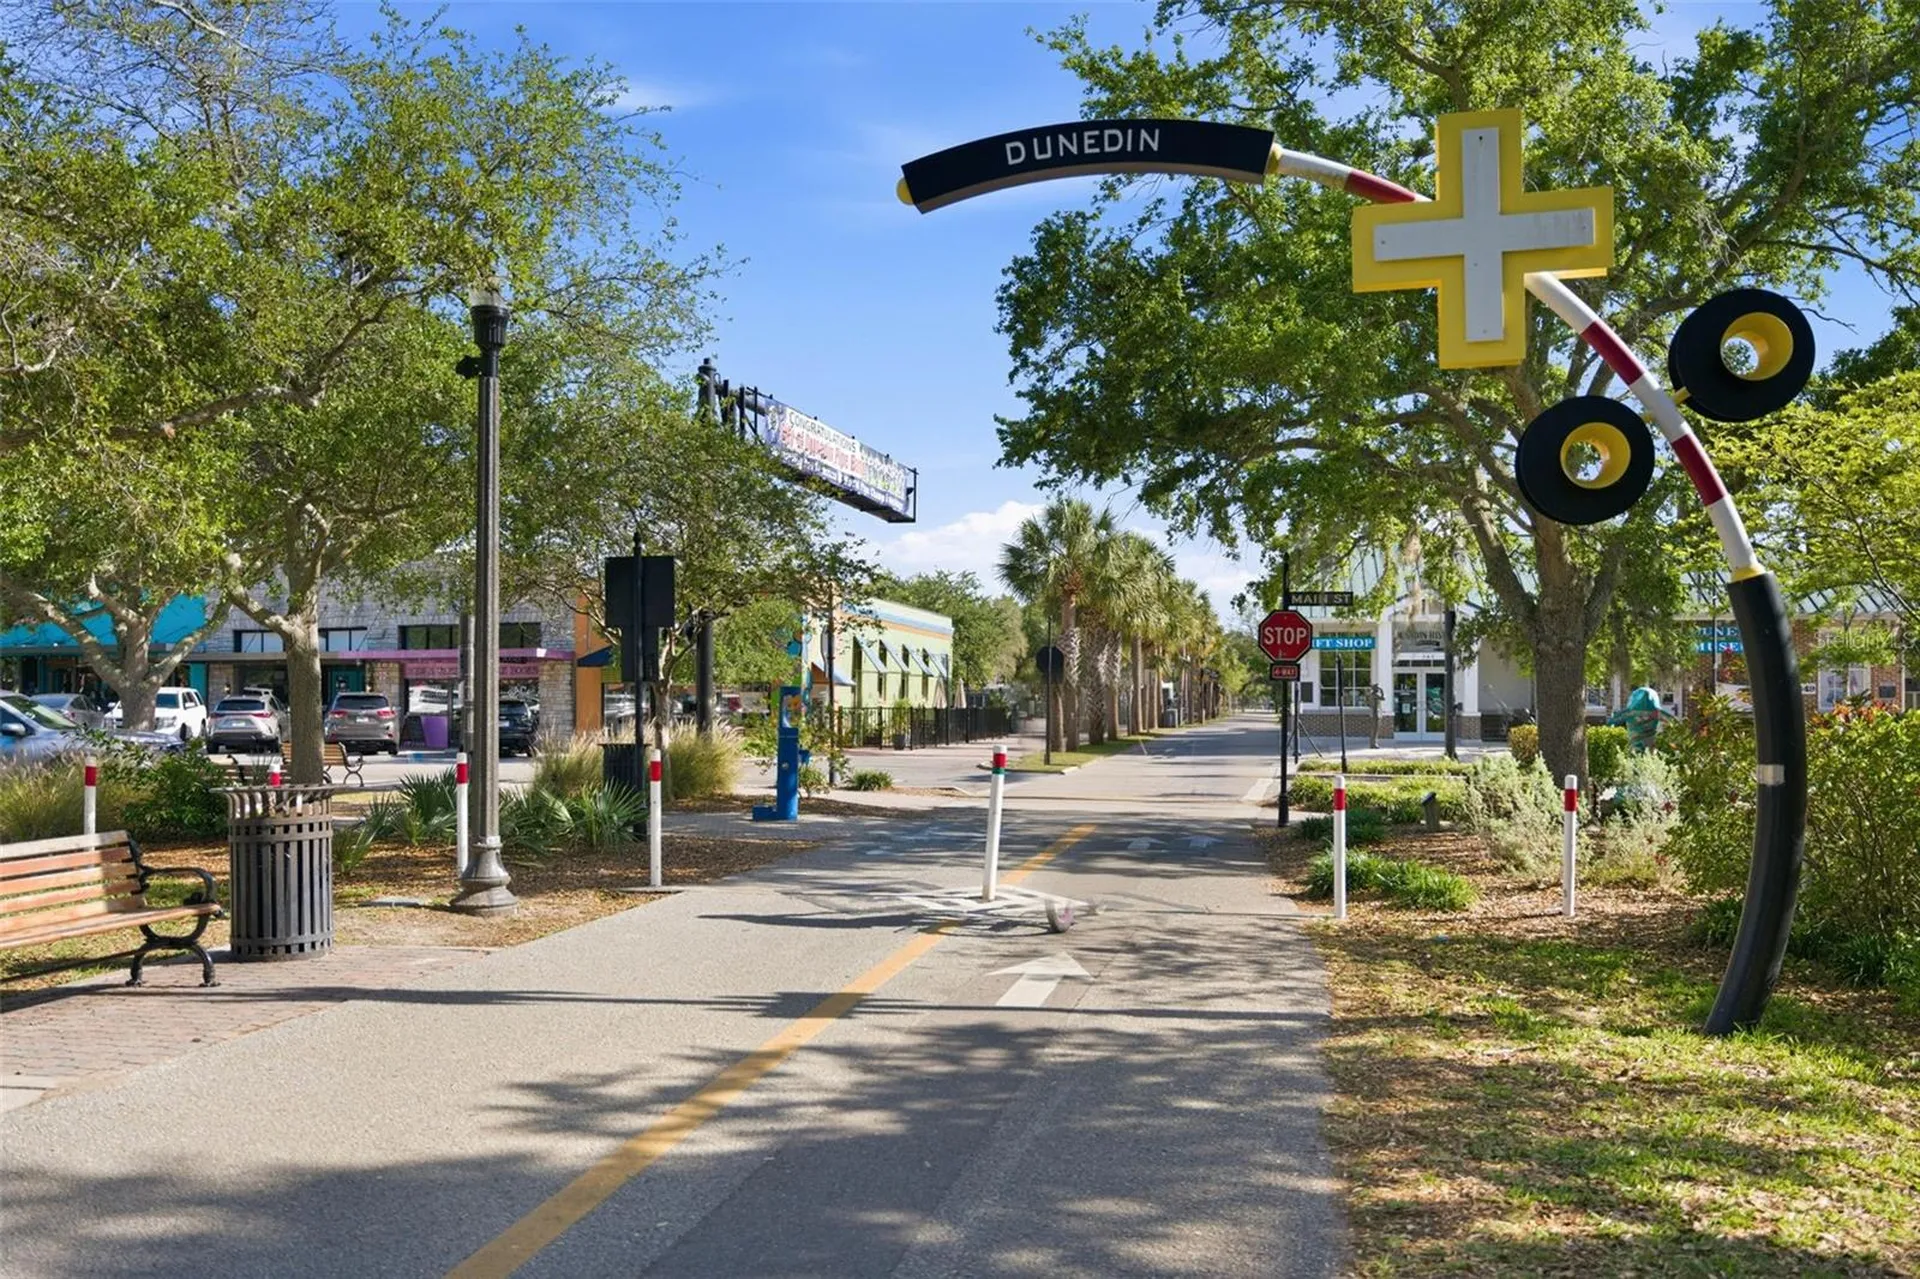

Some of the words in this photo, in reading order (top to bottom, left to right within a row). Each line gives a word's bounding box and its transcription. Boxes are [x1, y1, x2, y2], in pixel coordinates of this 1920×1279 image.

[1005, 128, 1160, 166] DUNEDIN
[789, 411, 857, 453] CONGRATULATIONS
[1291, 594, 1327, 604] MAIN
[1333, 594, 1350, 604] ST
[1264, 627, 1307, 645] STOP
[1312, 639, 1333, 648] IFT
[1336, 639, 1373, 648] SHOP
